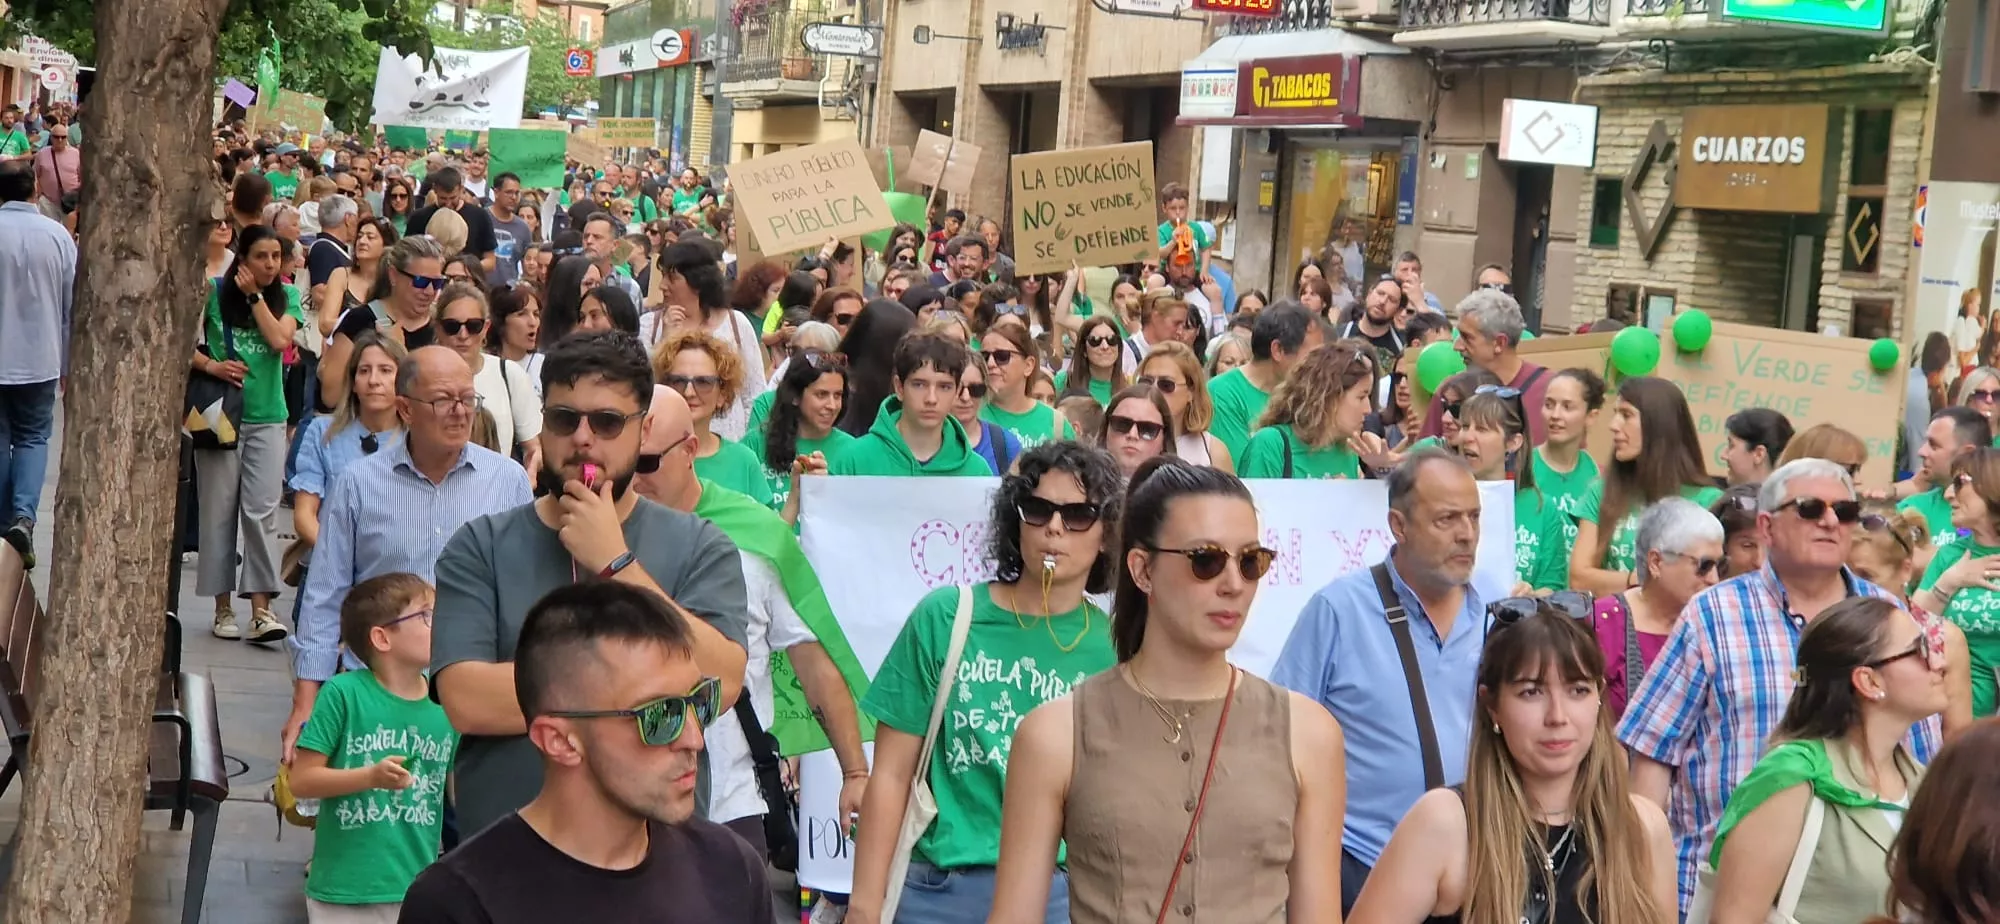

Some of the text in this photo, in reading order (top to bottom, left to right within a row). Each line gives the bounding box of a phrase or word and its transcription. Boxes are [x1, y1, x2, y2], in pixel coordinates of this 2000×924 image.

[1271, 73, 1331, 99] TABACOS
[1692, 136, 1805, 164] CUARZOS
[740, 150, 855, 190] DINERO PÚBLICO
[1021, 155, 1141, 190] LA EDUCACIÓN
[771, 179, 834, 203] PARA LA
[767, 194, 874, 239] PÚBLICA
[1023, 200, 1056, 231] NO
[1034, 225, 1150, 258] SE DEFIENDE
[1732, 340, 1832, 386] VERDE
[1847, 370, 1888, 394] SE
[958, 658, 1021, 690] CUELA
[953, 708, 985, 731] DE
[346, 729, 408, 756] ESCUELA
[336, 805, 392, 825] PARA
